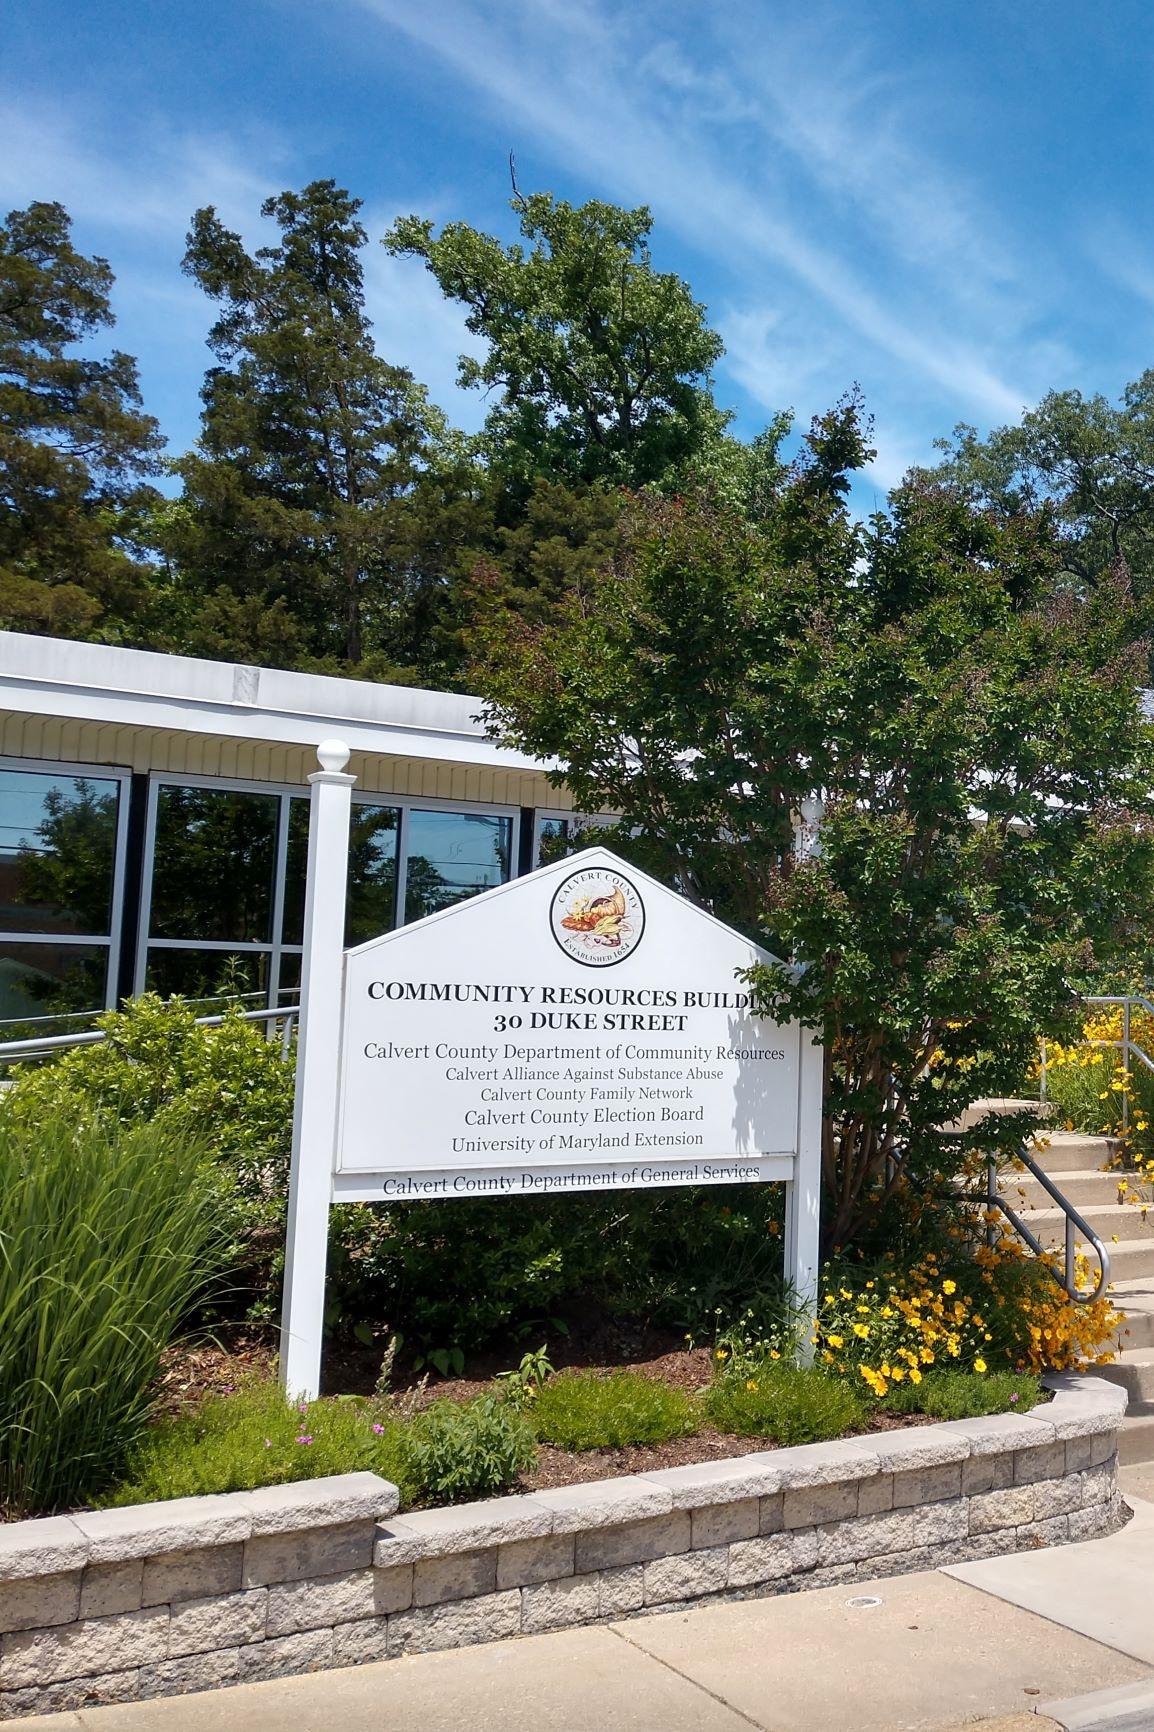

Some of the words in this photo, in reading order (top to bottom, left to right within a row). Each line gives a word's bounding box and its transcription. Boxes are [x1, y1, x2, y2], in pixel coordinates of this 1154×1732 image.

[558, 872, 602, 904] CALVERT
[605, 874, 639, 909] COUNTY
[563, 938, 613, 962] ESTABLISHED
[614, 942, 631, 958] 1654
[367, 981, 536, 1002] COMMUNITY
[540, 986, 677, 1007] RESOURCES
[493, 1014, 523, 1033] 30
[529, 1012, 598, 1030] DUKE
[603, 1013, 688, 1031] STREET
[364, 1042, 430, 1059] Calvert
[435, 1043, 499, 1063] County
[503, 1043, 602, 1062] Department
[606, 1044, 623, 1059] of
[625, 1045, 712, 1063] Community
[716, 1047, 785, 1060] Resources
[446, 1066, 498, 1081] Calvert
[502, 1067, 560, 1081] Alliance
[563, 1067, 614, 1083] Against
[618, 1067, 683, 1081] Substance
[686, 1067, 724, 1080] Abuse
[481, 1087, 532, 1102] Calvert
[536, 1087, 586, 1103] County
[590, 1087, 636, 1102] Family
[639, 1086, 693, 1100] Network
[465, 1109, 526, 1126] Calvert
[530, 1108, 589, 1127] County
[594, 1107, 655, 1123] Election
[661, 1106, 704, 1122] Board
[452, 1136, 535, 1153] University
[539, 1135, 556, 1150] of
[559, 1133, 629, 1152] Maryland
[634, 1131, 703, 1147] Extension
[383, 1178, 448, 1195] Calvert
[453, 1175, 515, 1193] County
[521, 1172, 617, 1191] Department
[621, 1168, 638, 1184] of
[641, 1166, 698, 1183] General
[702, 1164, 760, 1180] Services
